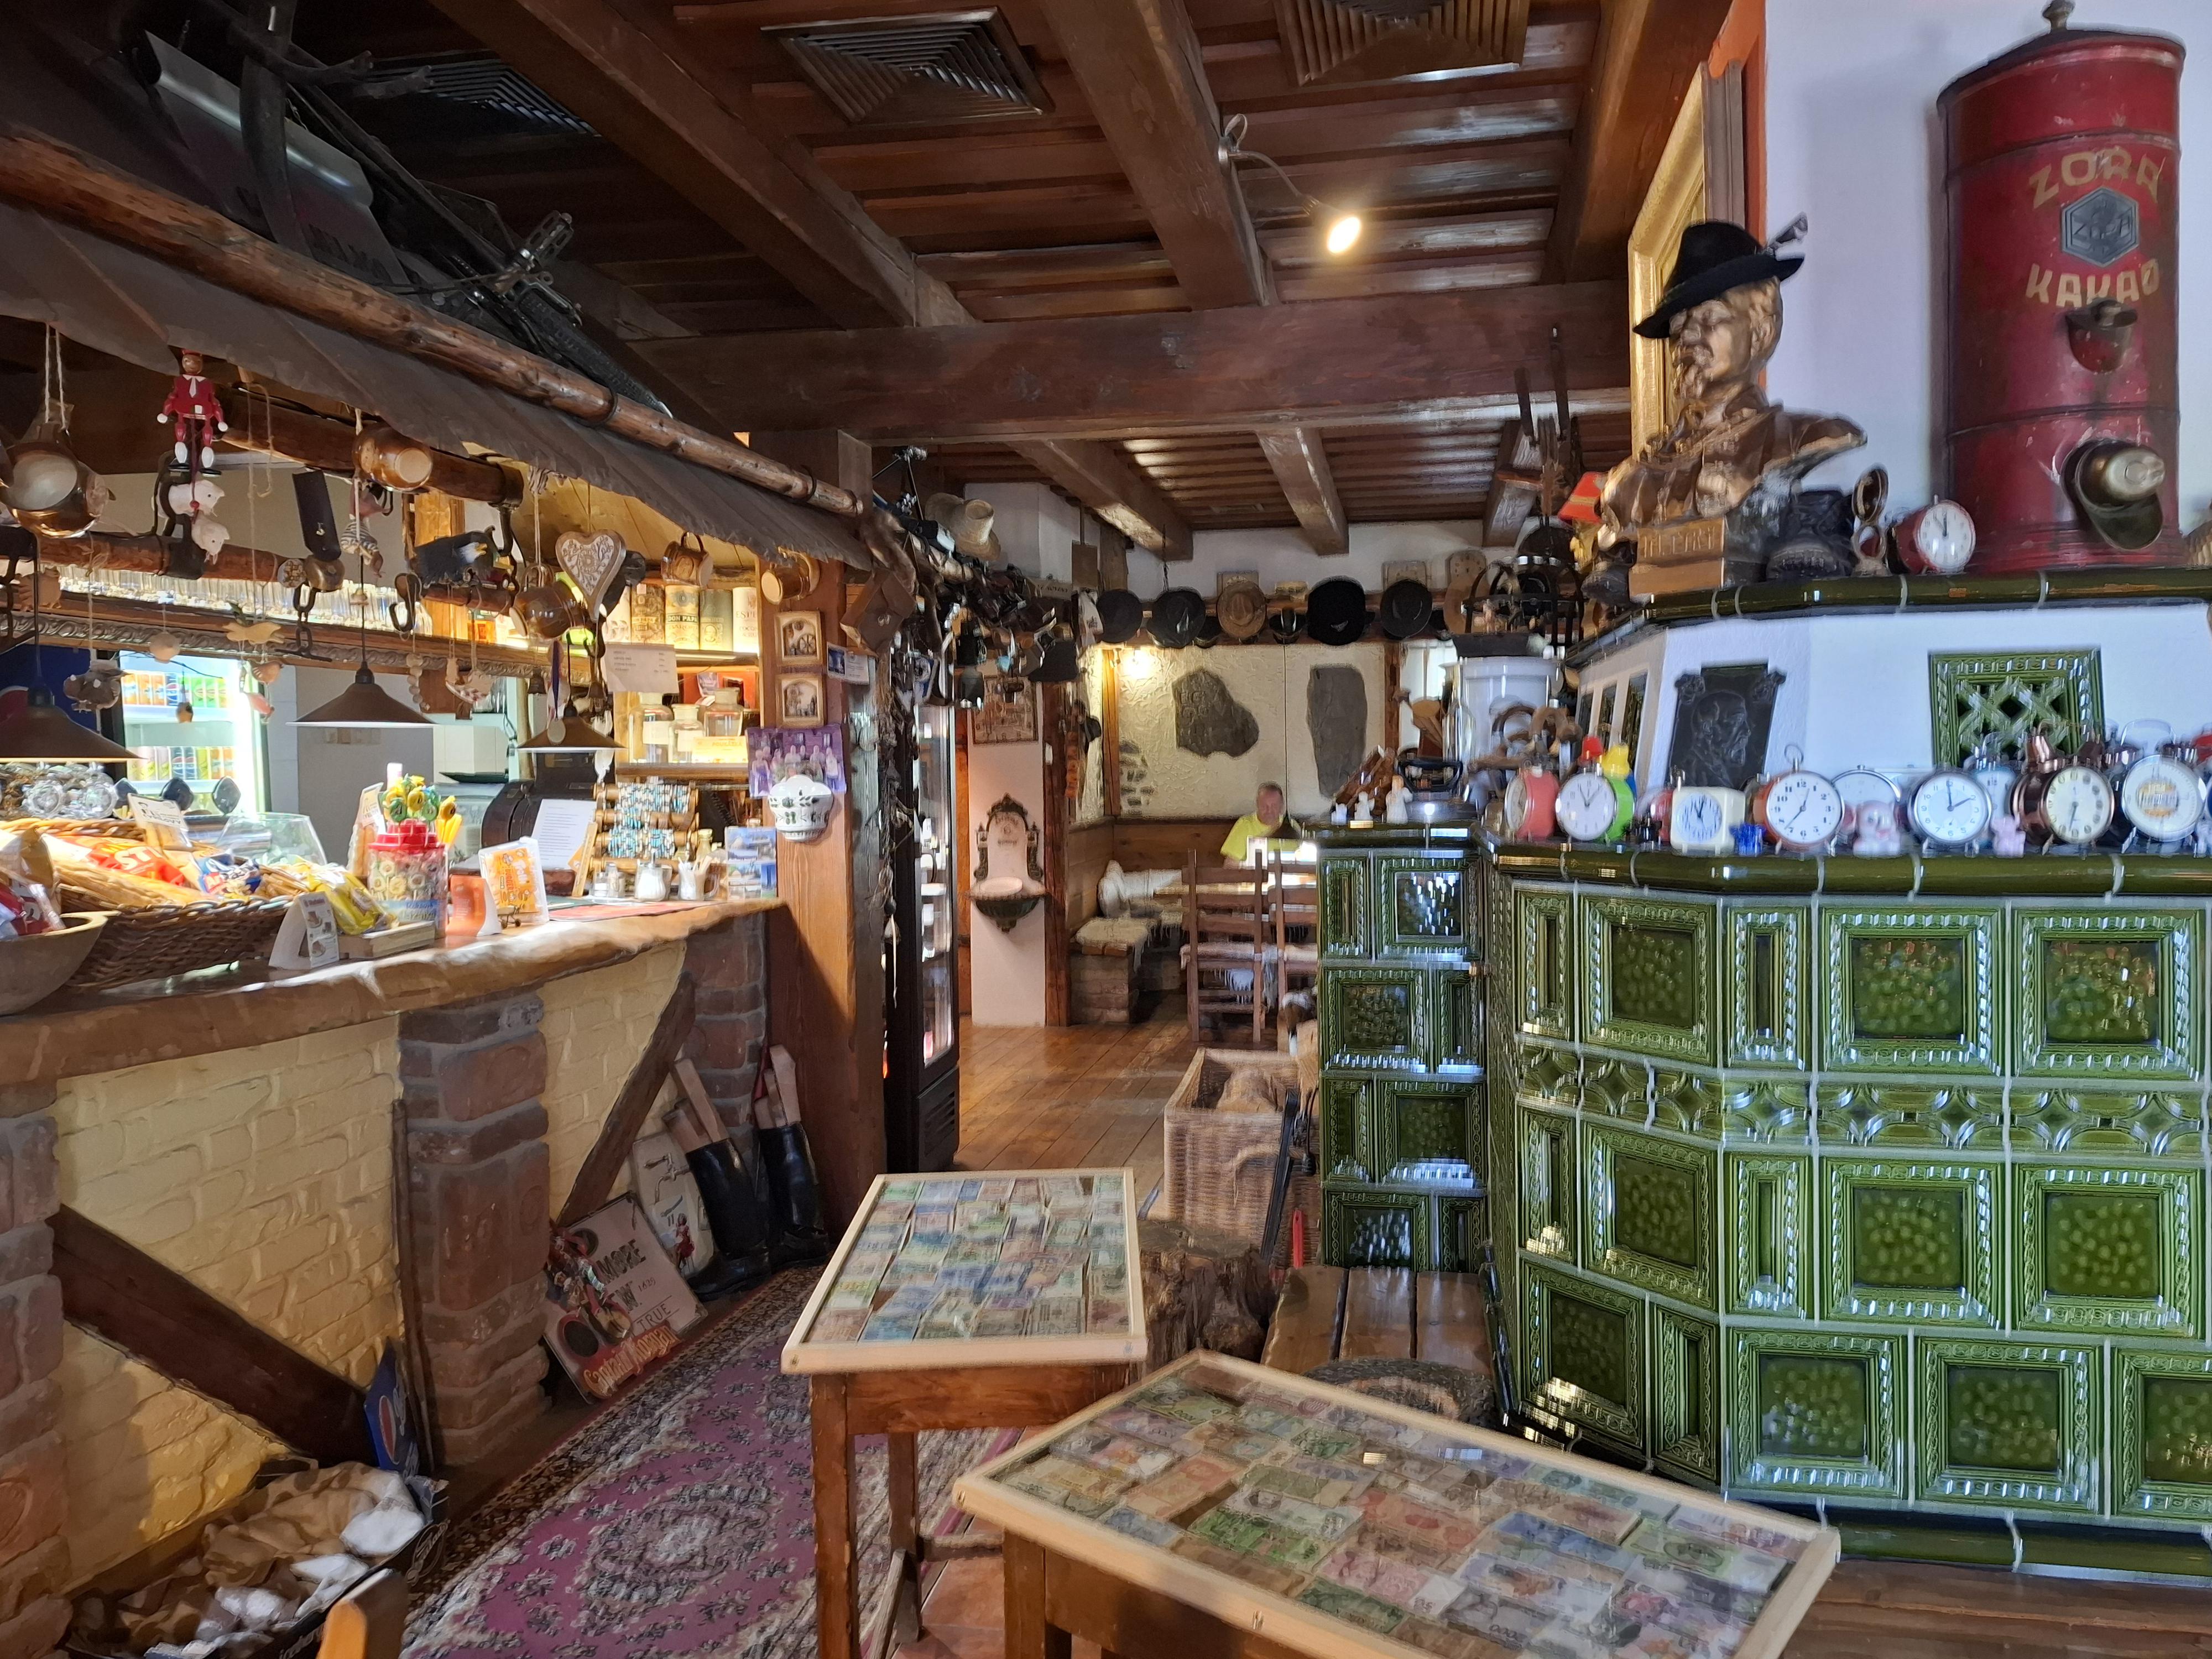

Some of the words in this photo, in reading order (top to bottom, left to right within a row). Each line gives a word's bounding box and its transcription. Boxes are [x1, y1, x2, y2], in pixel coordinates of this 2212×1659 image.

[2029, 145, 2159, 204] ZORA
[2026, 258, 2160, 307] KAKAO
[637, 1303, 671, 1331] TRUE
[583, 1349, 634, 1399] Captain
